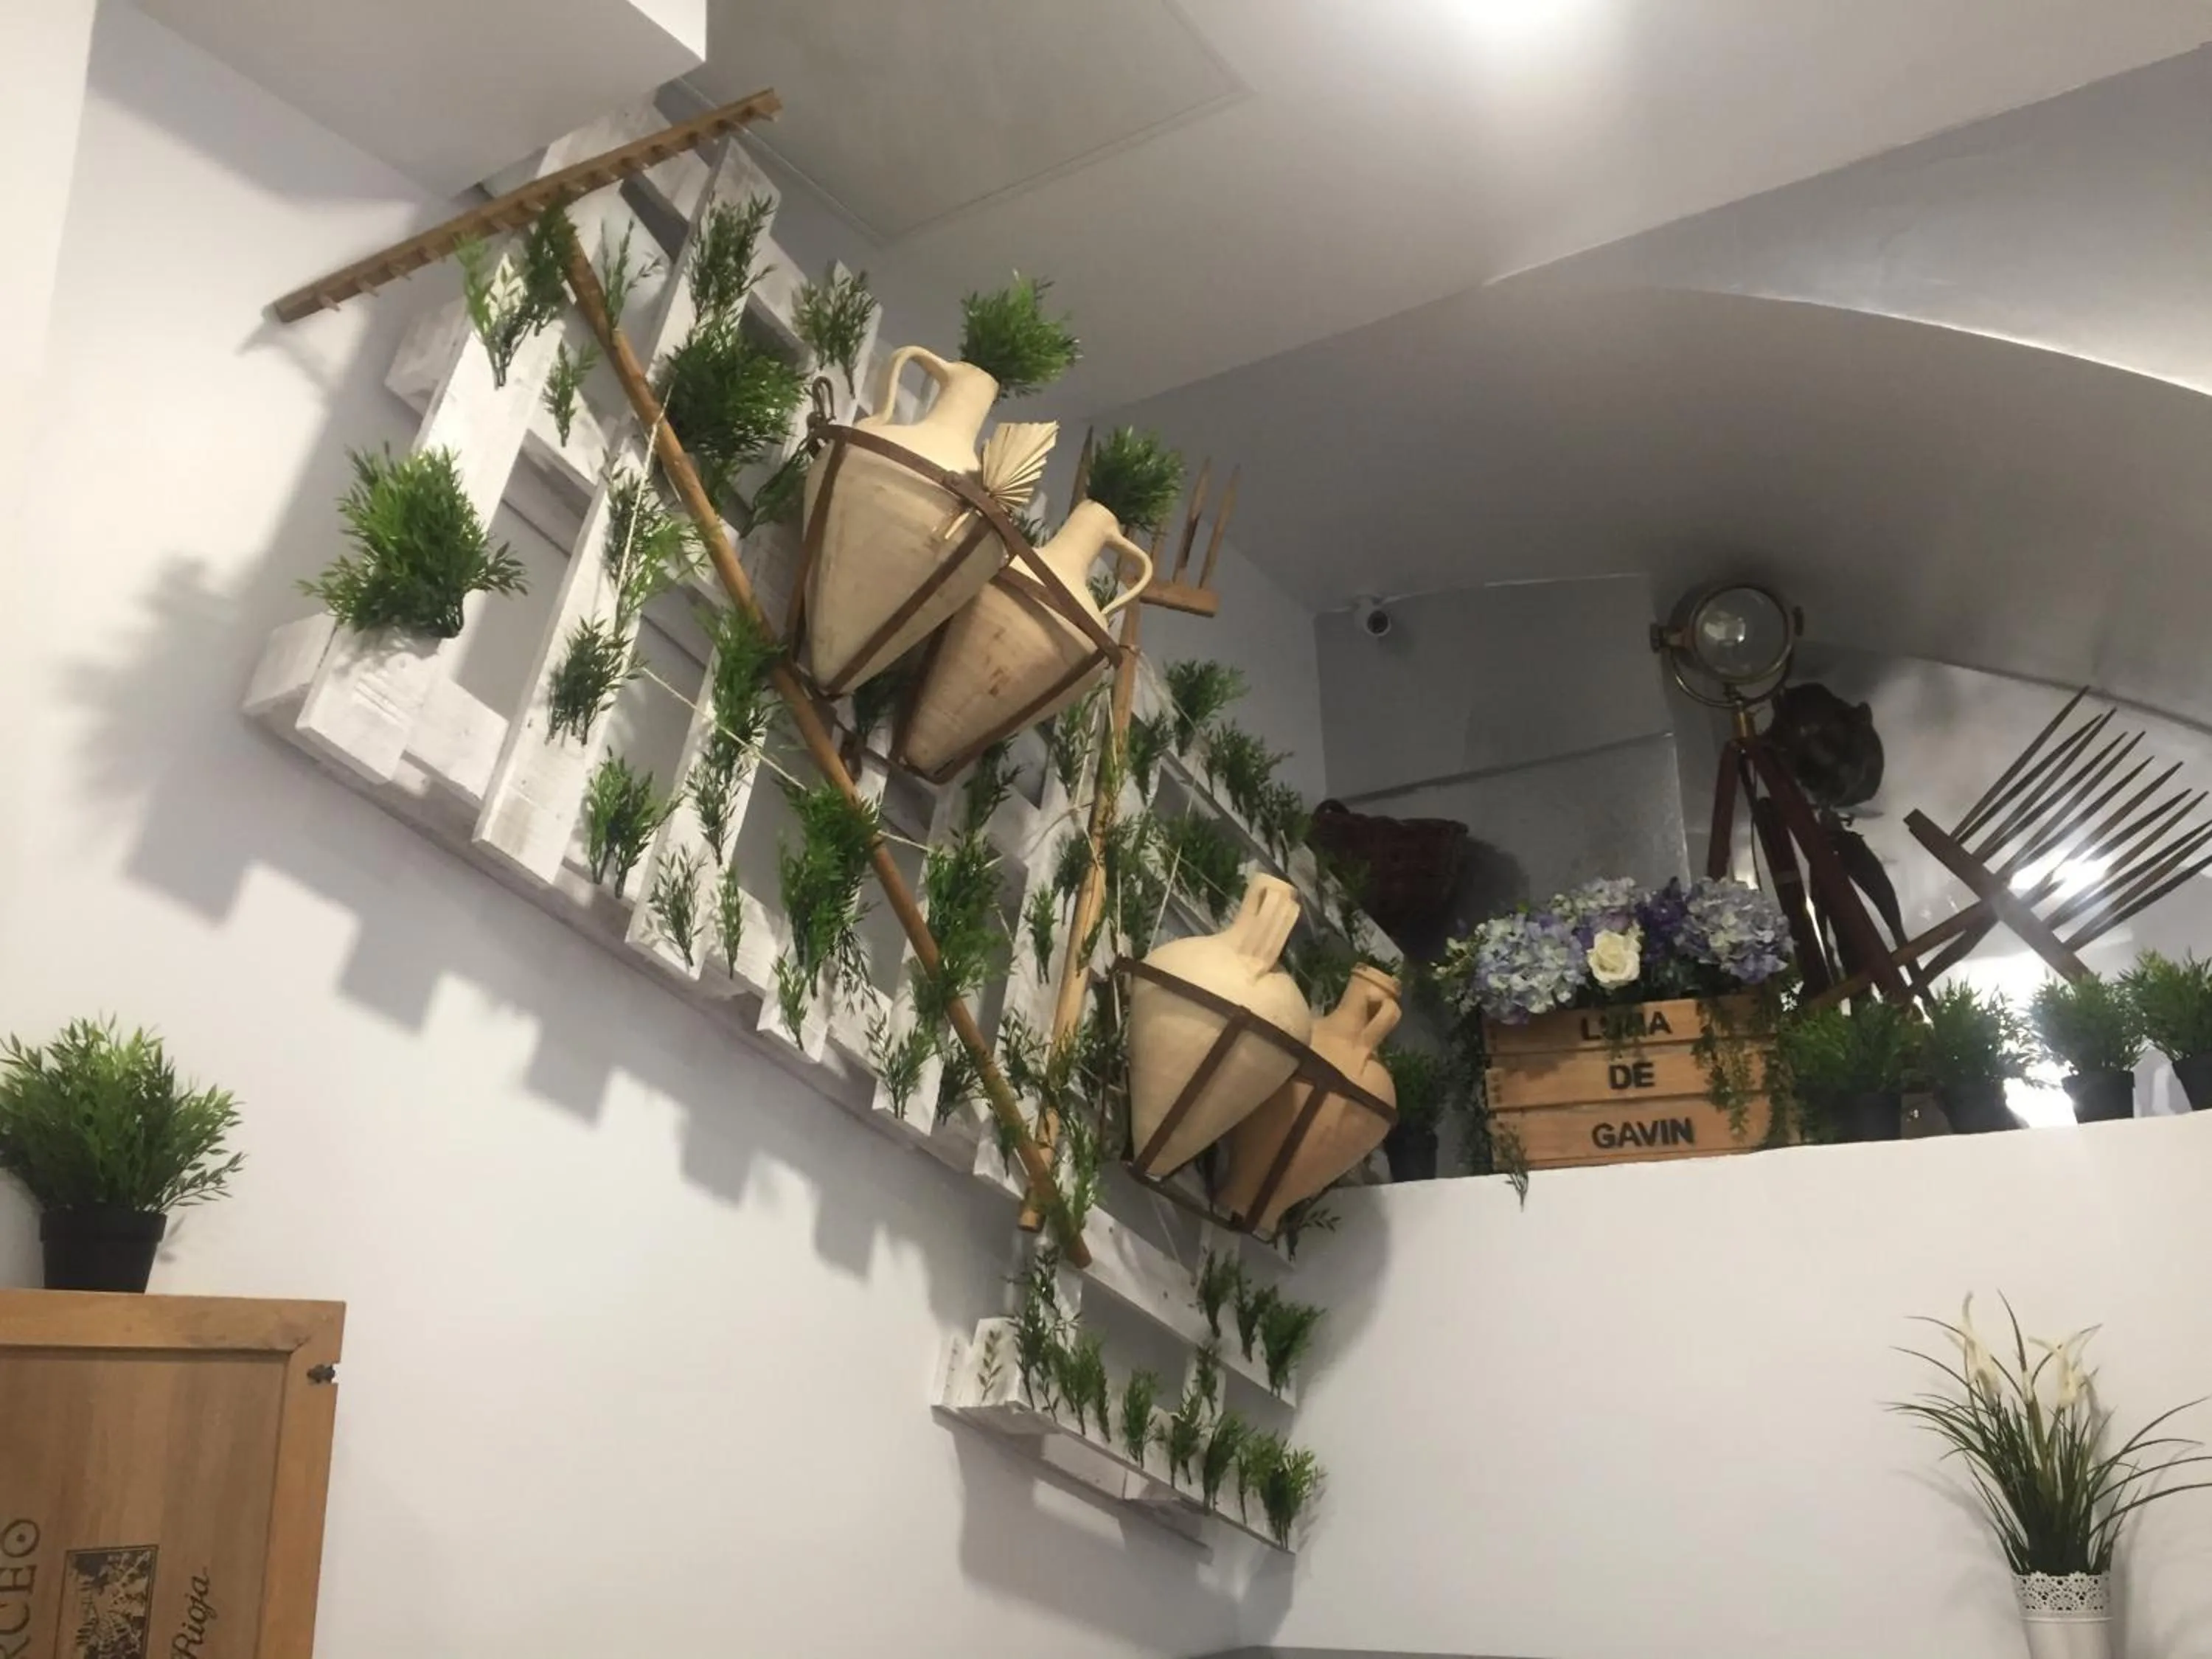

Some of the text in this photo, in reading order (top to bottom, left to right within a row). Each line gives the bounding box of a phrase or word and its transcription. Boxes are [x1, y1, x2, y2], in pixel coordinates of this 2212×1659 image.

[1609, 1062, 1655, 1090] DE
[1592, 1118, 1694, 1149] GAVIN
[170, 1567, 217, 1659] Rioja
